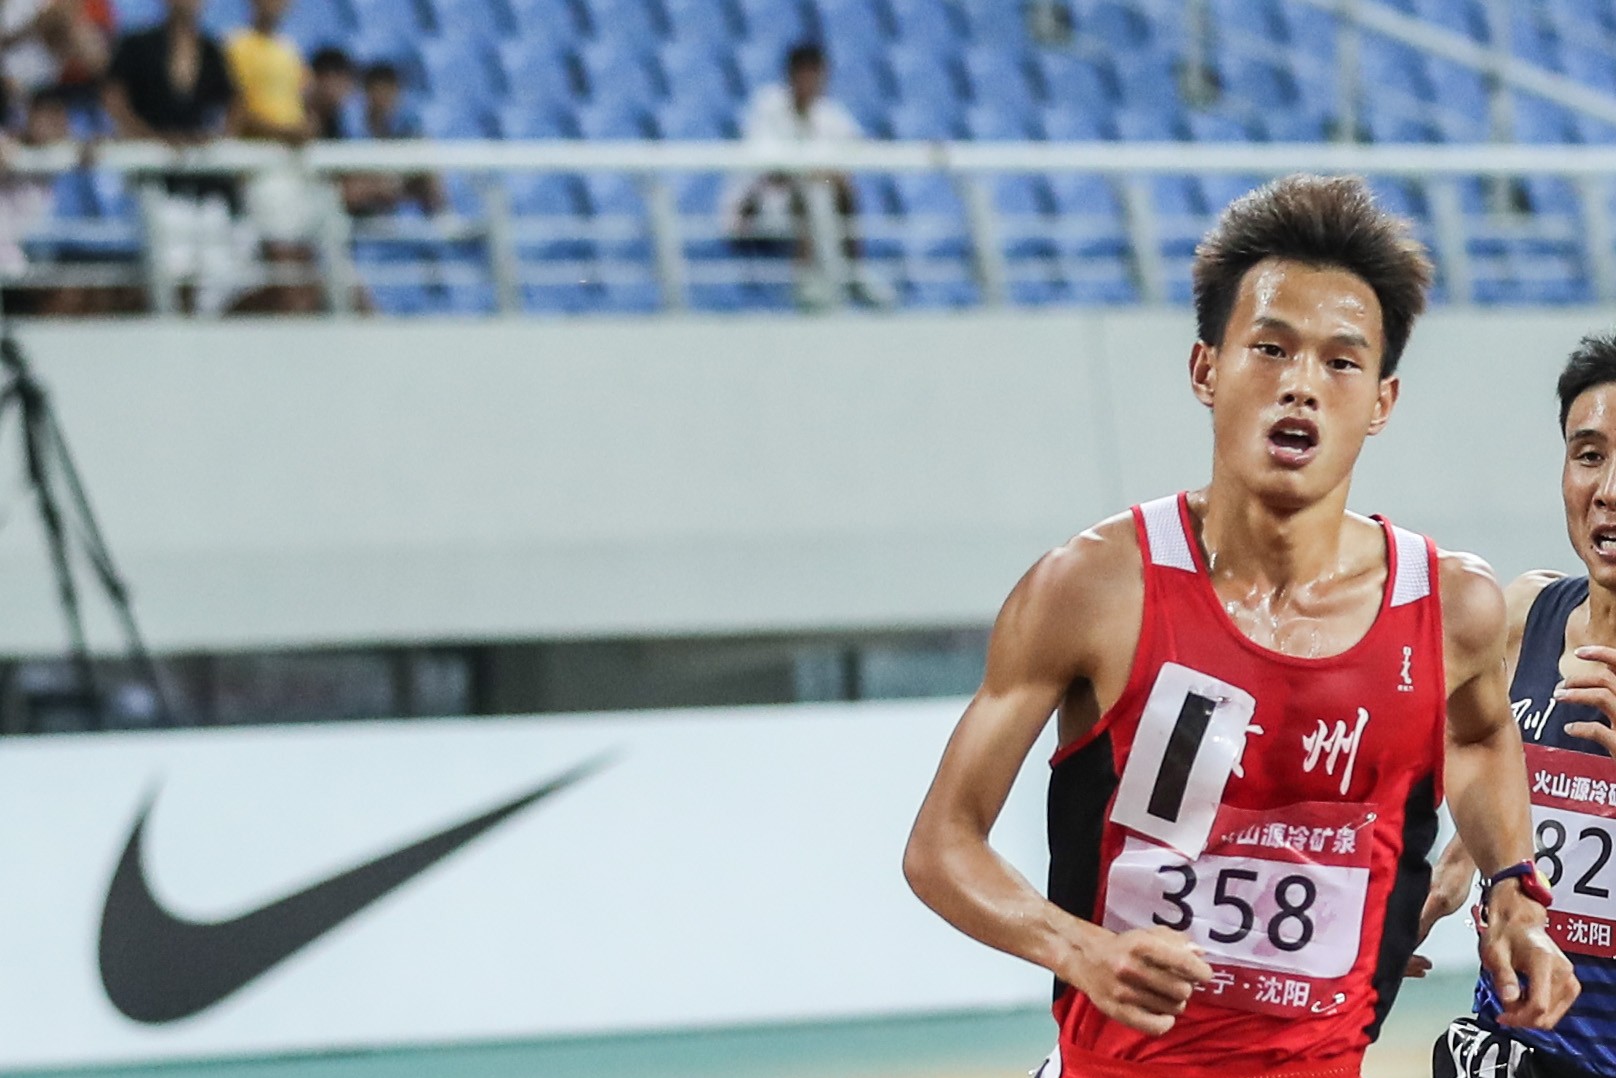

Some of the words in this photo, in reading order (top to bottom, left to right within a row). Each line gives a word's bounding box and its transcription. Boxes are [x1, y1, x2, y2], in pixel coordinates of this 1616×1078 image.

[1151, 864, 1317, 952] 358
[1544, 917, 1612, 947] ·沈阳
[1193, 969, 1312, 1008] 宁·沈阳
